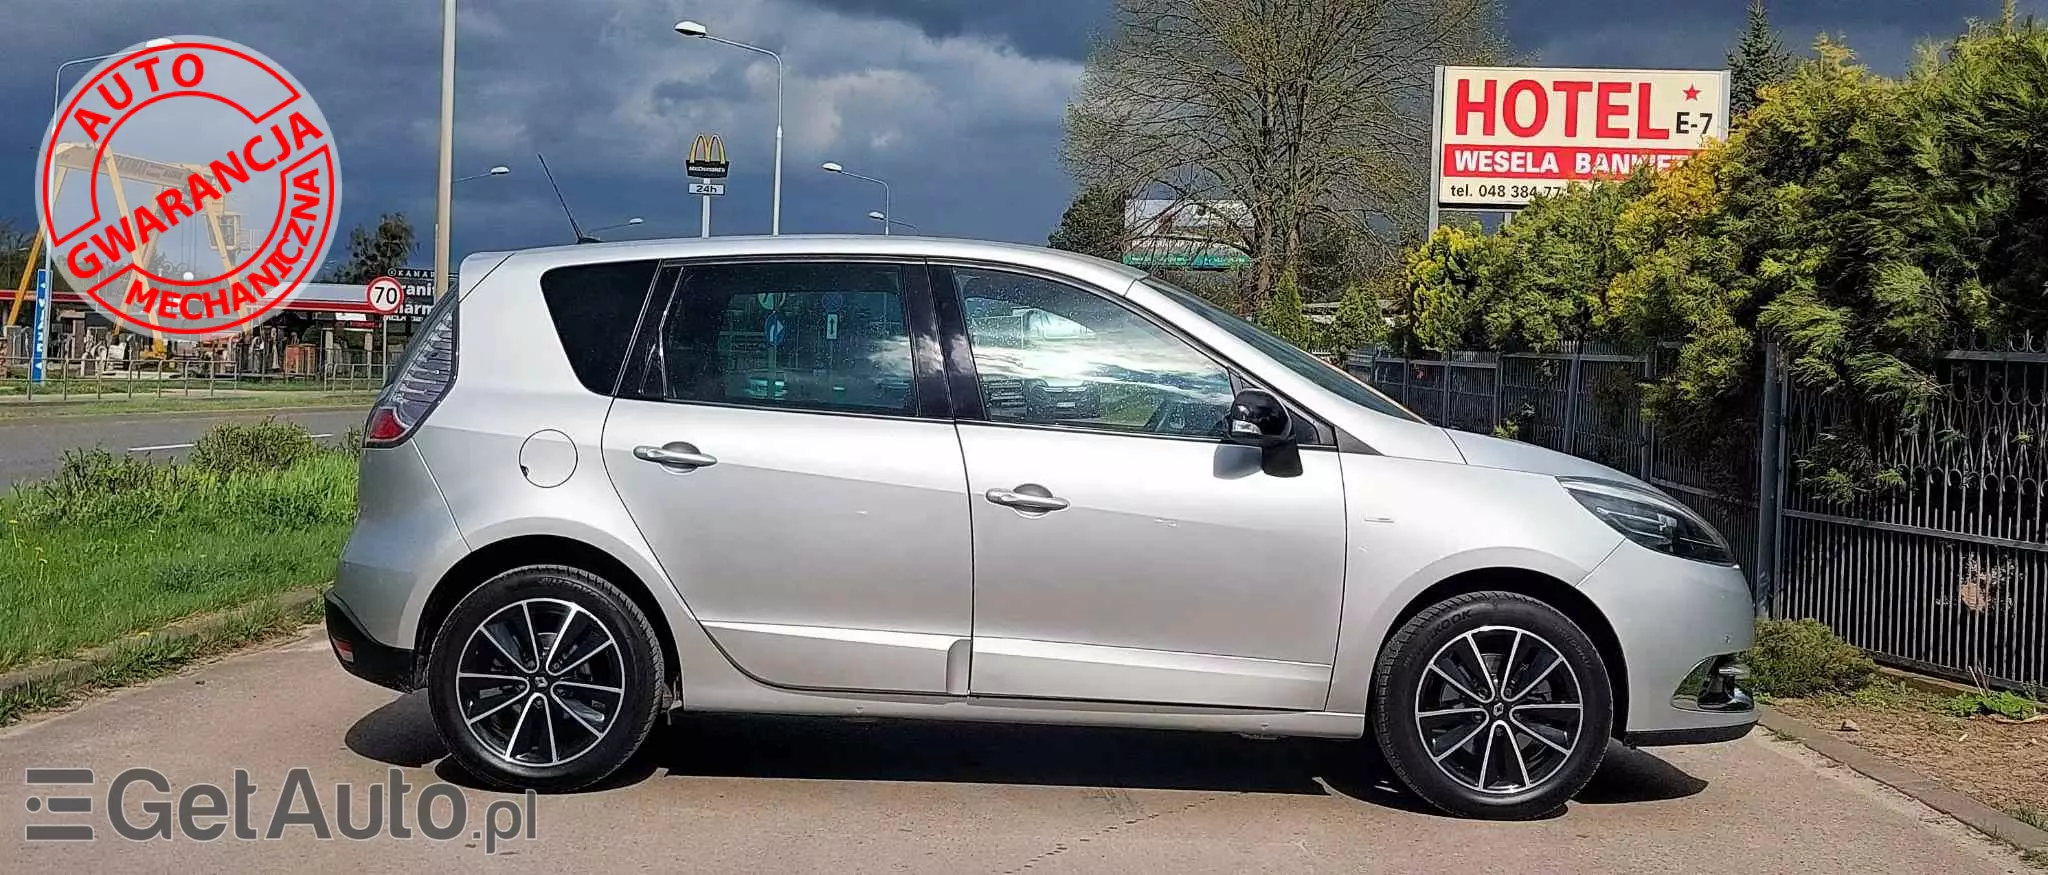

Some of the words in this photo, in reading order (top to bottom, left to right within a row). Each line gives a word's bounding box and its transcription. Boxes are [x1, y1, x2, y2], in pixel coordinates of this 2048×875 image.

[1455, 78, 1670, 140] HOTEL
[1676, 111, 1713, 134] E-7
[1454, 149, 1560, 174] WESELA
[696, 184, 717, 193] 24h
[1450, 184, 1473, 197] tel.
[1479, 184, 1506, 198] 048
[1510, 185, 1537, 199] 384
[374, 286, 398, 304] 70
